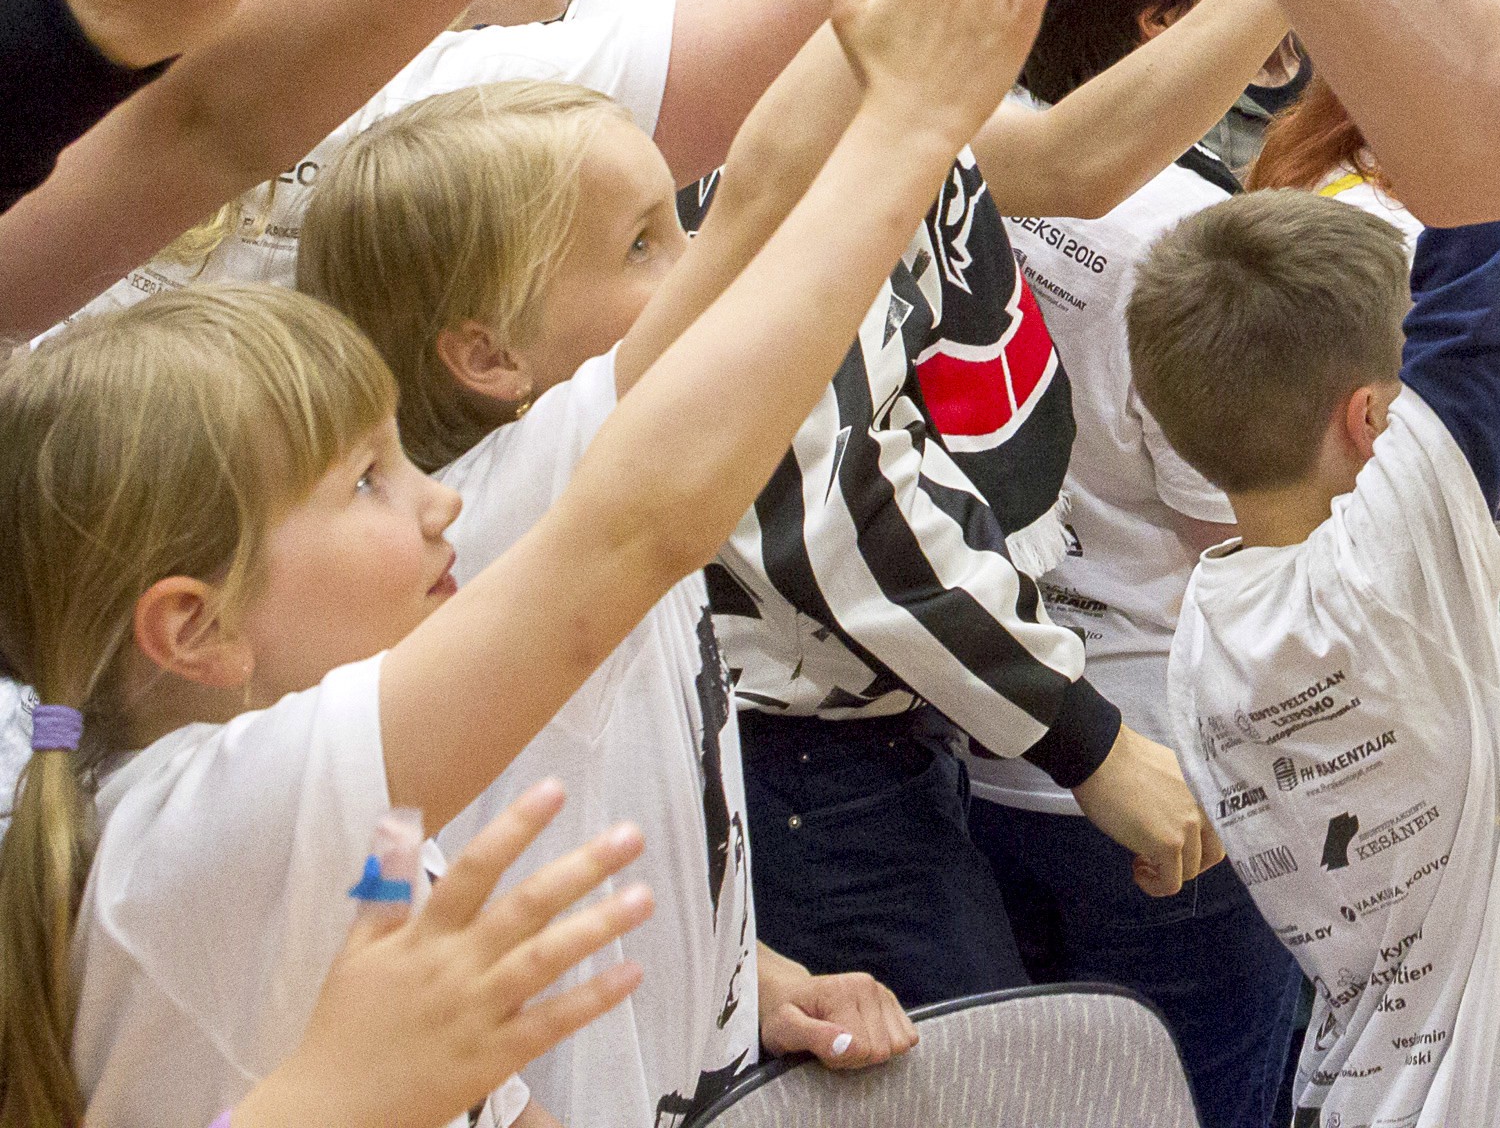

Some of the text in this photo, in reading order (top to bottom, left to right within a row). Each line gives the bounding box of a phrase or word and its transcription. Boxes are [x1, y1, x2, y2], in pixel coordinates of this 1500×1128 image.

[1062, 239, 1108, 274] 2016
[1035, 273, 1087, 311] RAKENTAJAT
[1280, 670, 1346, 712] PELTOLAN
[1316, 730, 1397, 778] RAKENTAJAT
[1355, 805, 1440, 861] KESÄNEN
[1405, 855, 1450, 889] KOUVO
